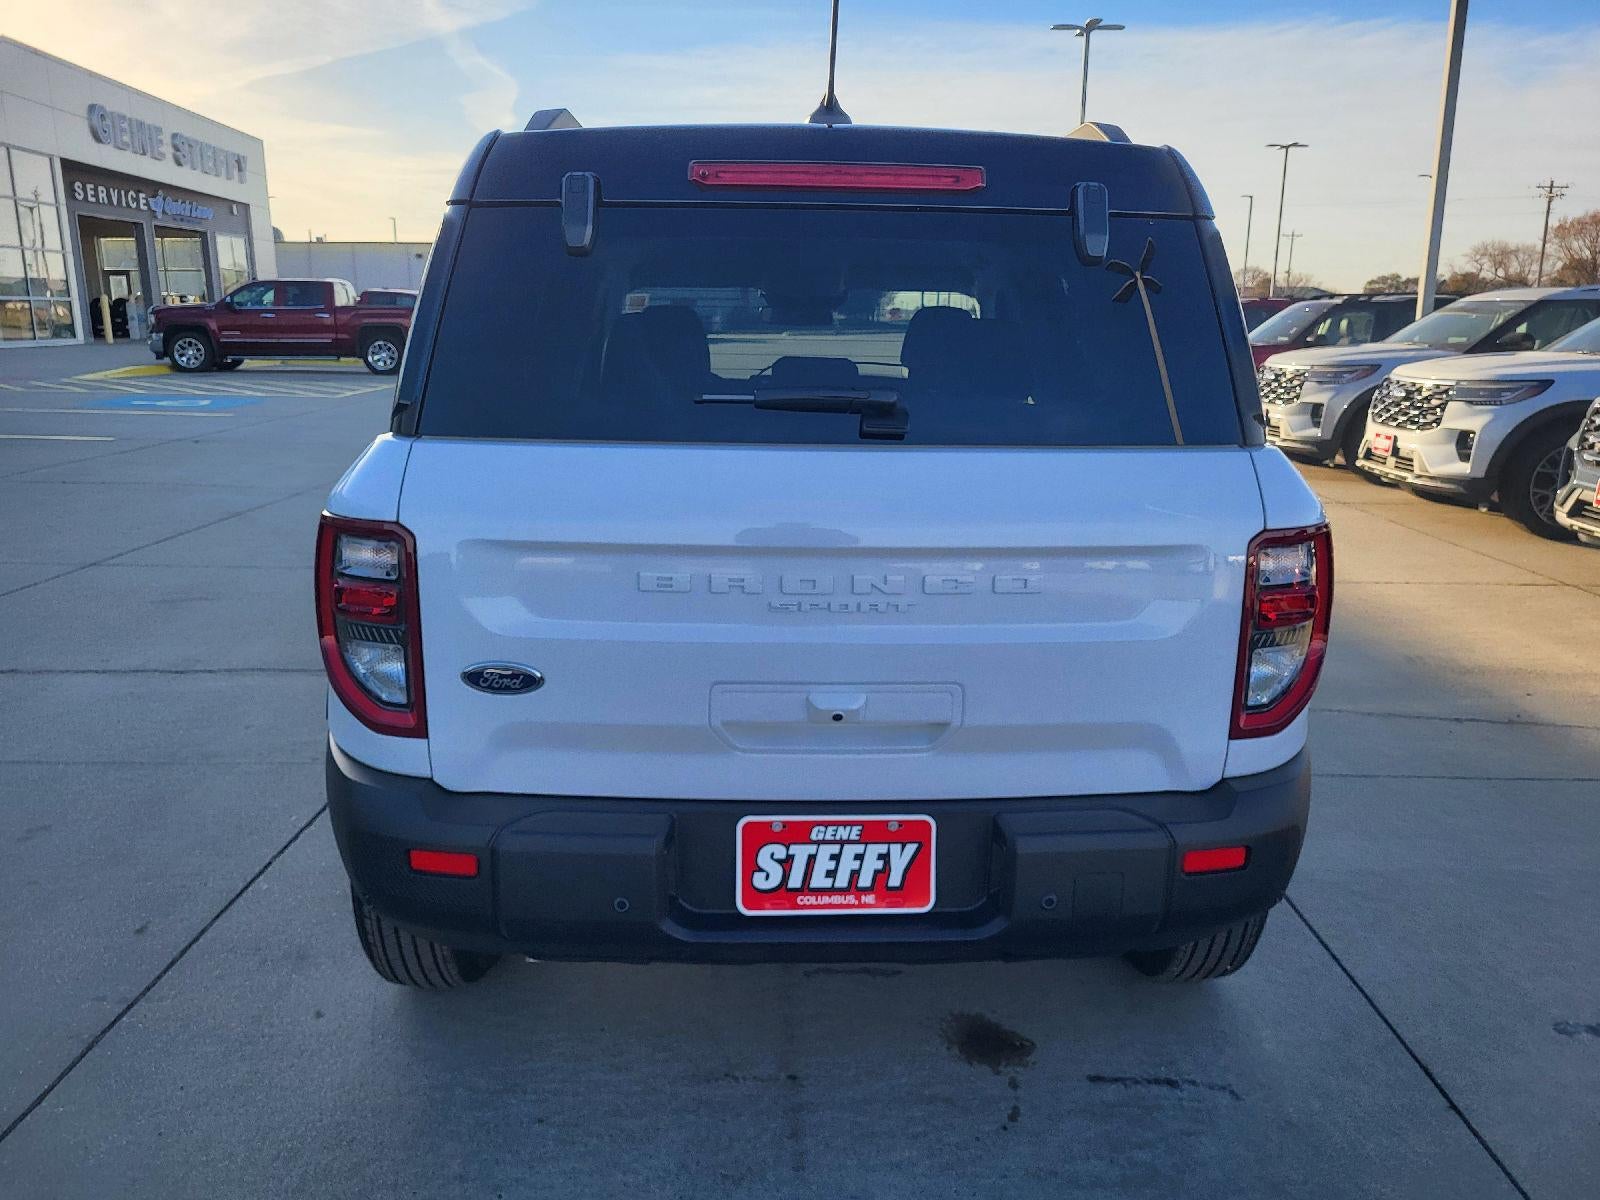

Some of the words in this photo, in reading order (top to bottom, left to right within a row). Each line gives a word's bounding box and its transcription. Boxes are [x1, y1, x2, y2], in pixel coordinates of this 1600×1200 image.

[88, 103, 166, 161] GENE
[171, 132, 248, 184] STEFFY
[74, 181, 148, 211] SERVICE
[637, 571, 1042, 595] BRONCO
[768, 600, 917, 613] SPORT
[480, 668, 524, 689] Ford
[809, 825, 863, 841] GENE
[751, 842, 922, 892] STEFFY
[796, 895, 858, 905] COLUMBUS,
[861, 894, 876, 904] NE
